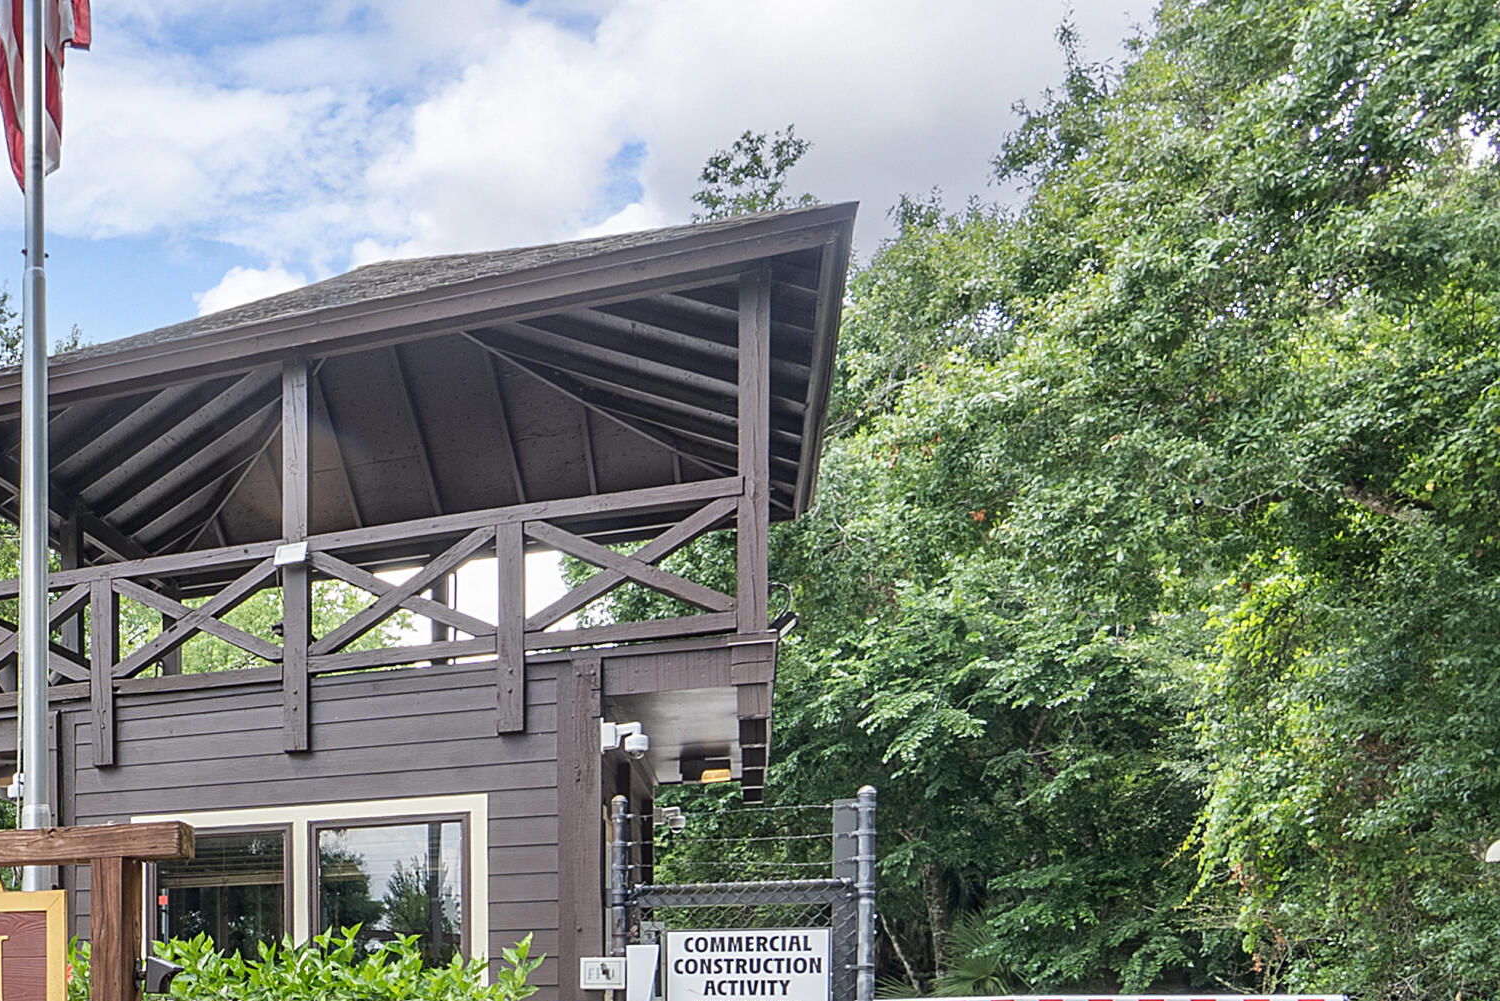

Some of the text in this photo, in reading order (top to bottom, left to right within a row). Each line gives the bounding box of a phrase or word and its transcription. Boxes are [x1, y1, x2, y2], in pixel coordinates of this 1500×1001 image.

[684, 935, 812, 953] COMMERCIAL
[674, 957, 822, 975] CONSTRUCTION
[703, 979, 791, 996] ACTIVITY
